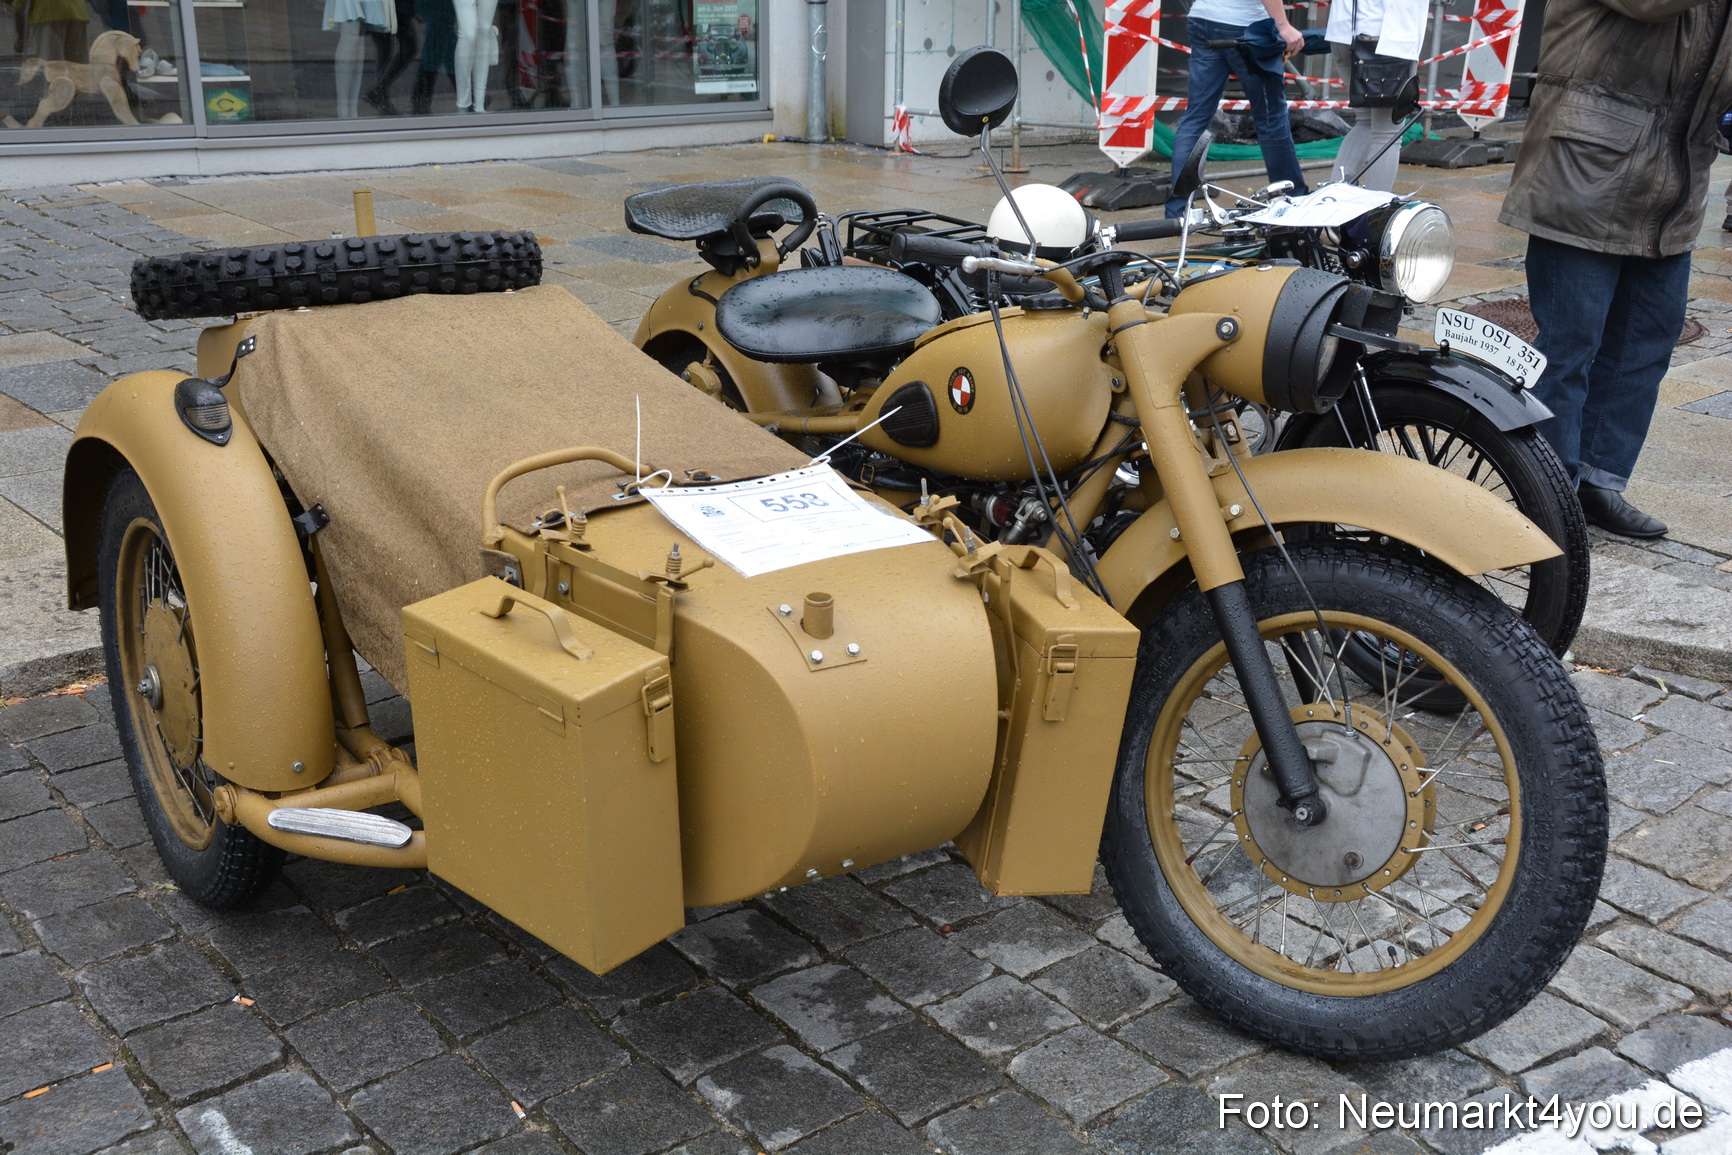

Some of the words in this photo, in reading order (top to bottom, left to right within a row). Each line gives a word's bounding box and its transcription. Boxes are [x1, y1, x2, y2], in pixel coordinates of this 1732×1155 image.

[1441, 312, 1475, 331] NSU
[1482, 324, 1512, 349] OSL
[1517, 345, 1541, 371] 351
[1445, 329, 1478, 346] Baujahr
[1480, 340, 1500, 355] 1937
[1506, 355, 1515, 367] 18
[1516, 363, 1529, 377] PS
[759, 492, 830, 513] 558
